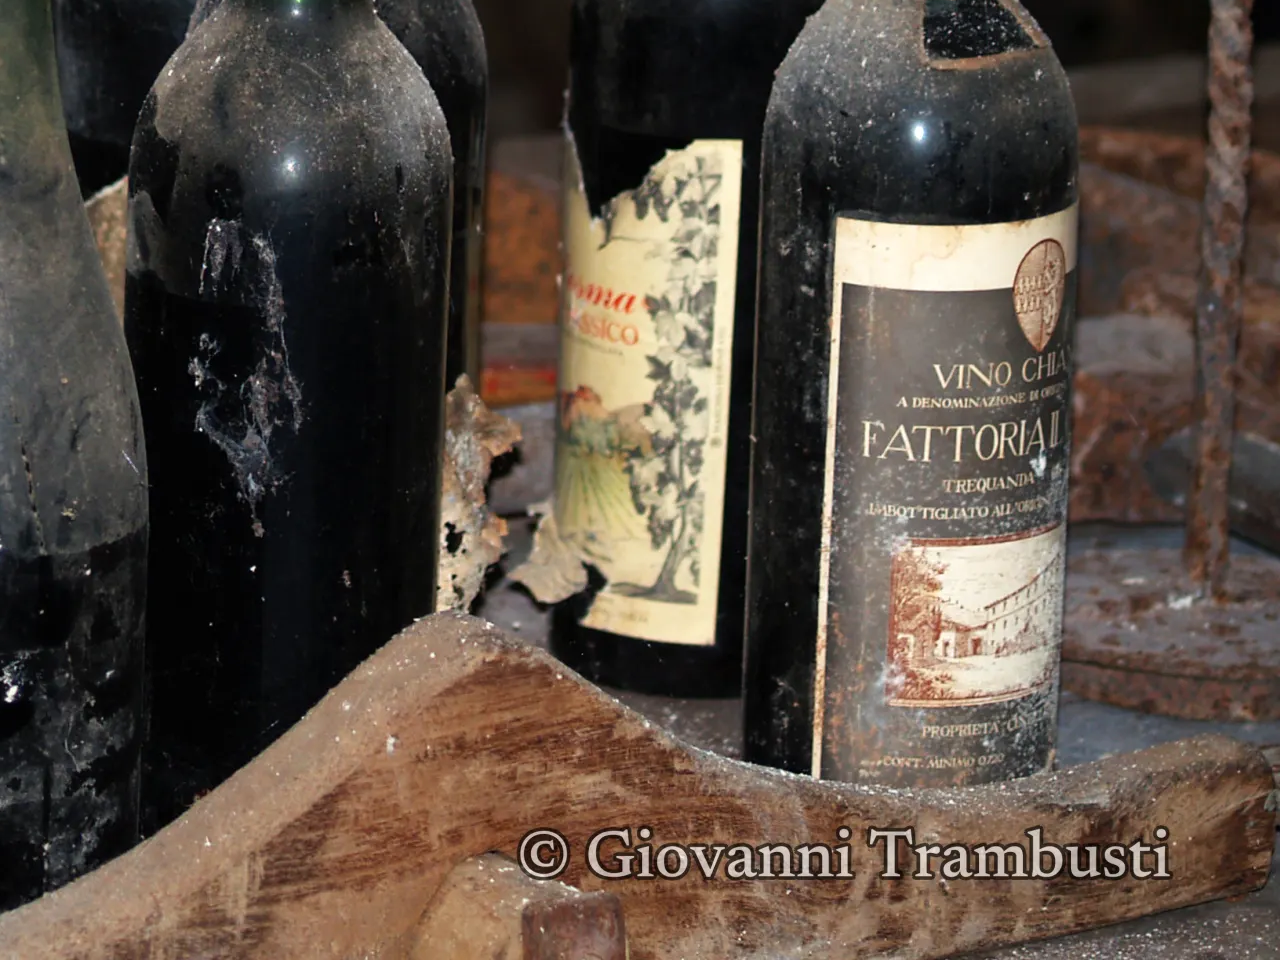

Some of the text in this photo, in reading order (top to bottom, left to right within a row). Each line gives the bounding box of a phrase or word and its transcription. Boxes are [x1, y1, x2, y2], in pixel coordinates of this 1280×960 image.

[933, 361, 1012, 389] VINO
[896, 396, 908, 408] A
[912, 392, 1026, 409] DENOMINAZIONE
[862, 417, 1044, 463] FATTORIA
[942, 471, 1035, 494] TREQUANDA
